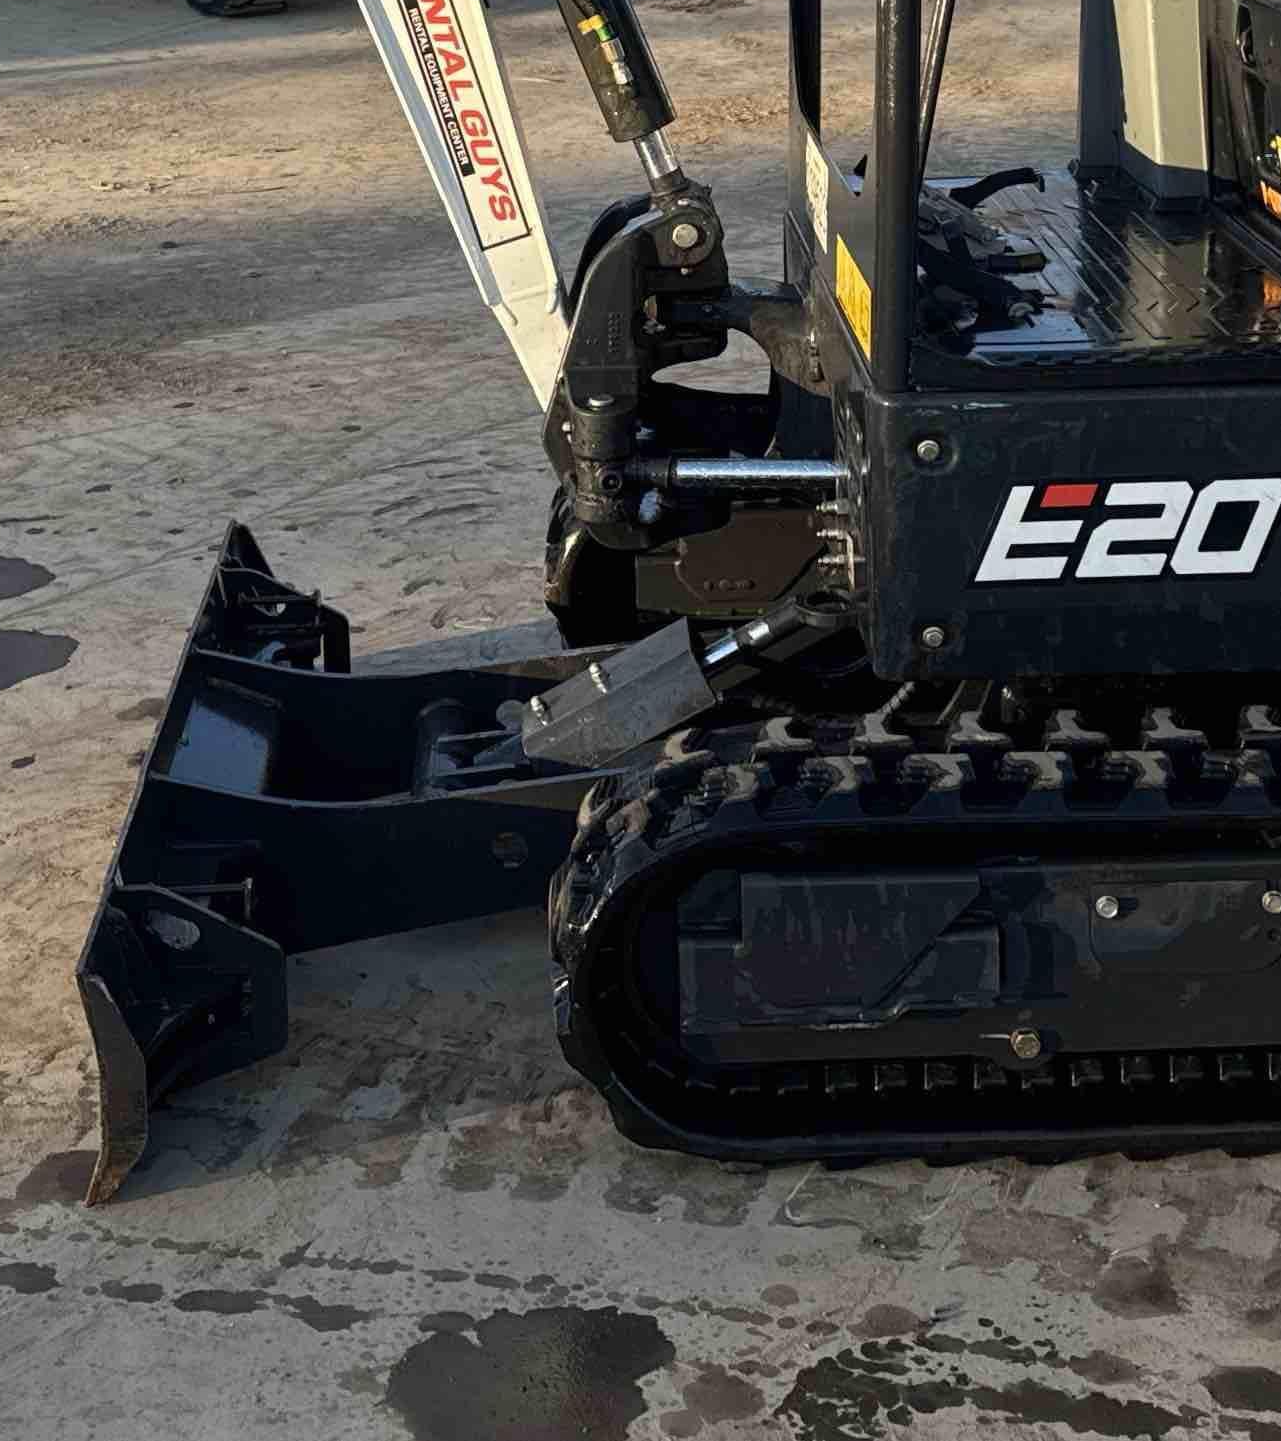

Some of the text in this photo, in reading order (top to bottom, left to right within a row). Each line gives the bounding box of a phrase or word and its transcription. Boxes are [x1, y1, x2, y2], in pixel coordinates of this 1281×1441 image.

[409, 7, 469, 167] RENTAL EQUIPMENT CENTER
[460, 109, 517, 222] GUYS
